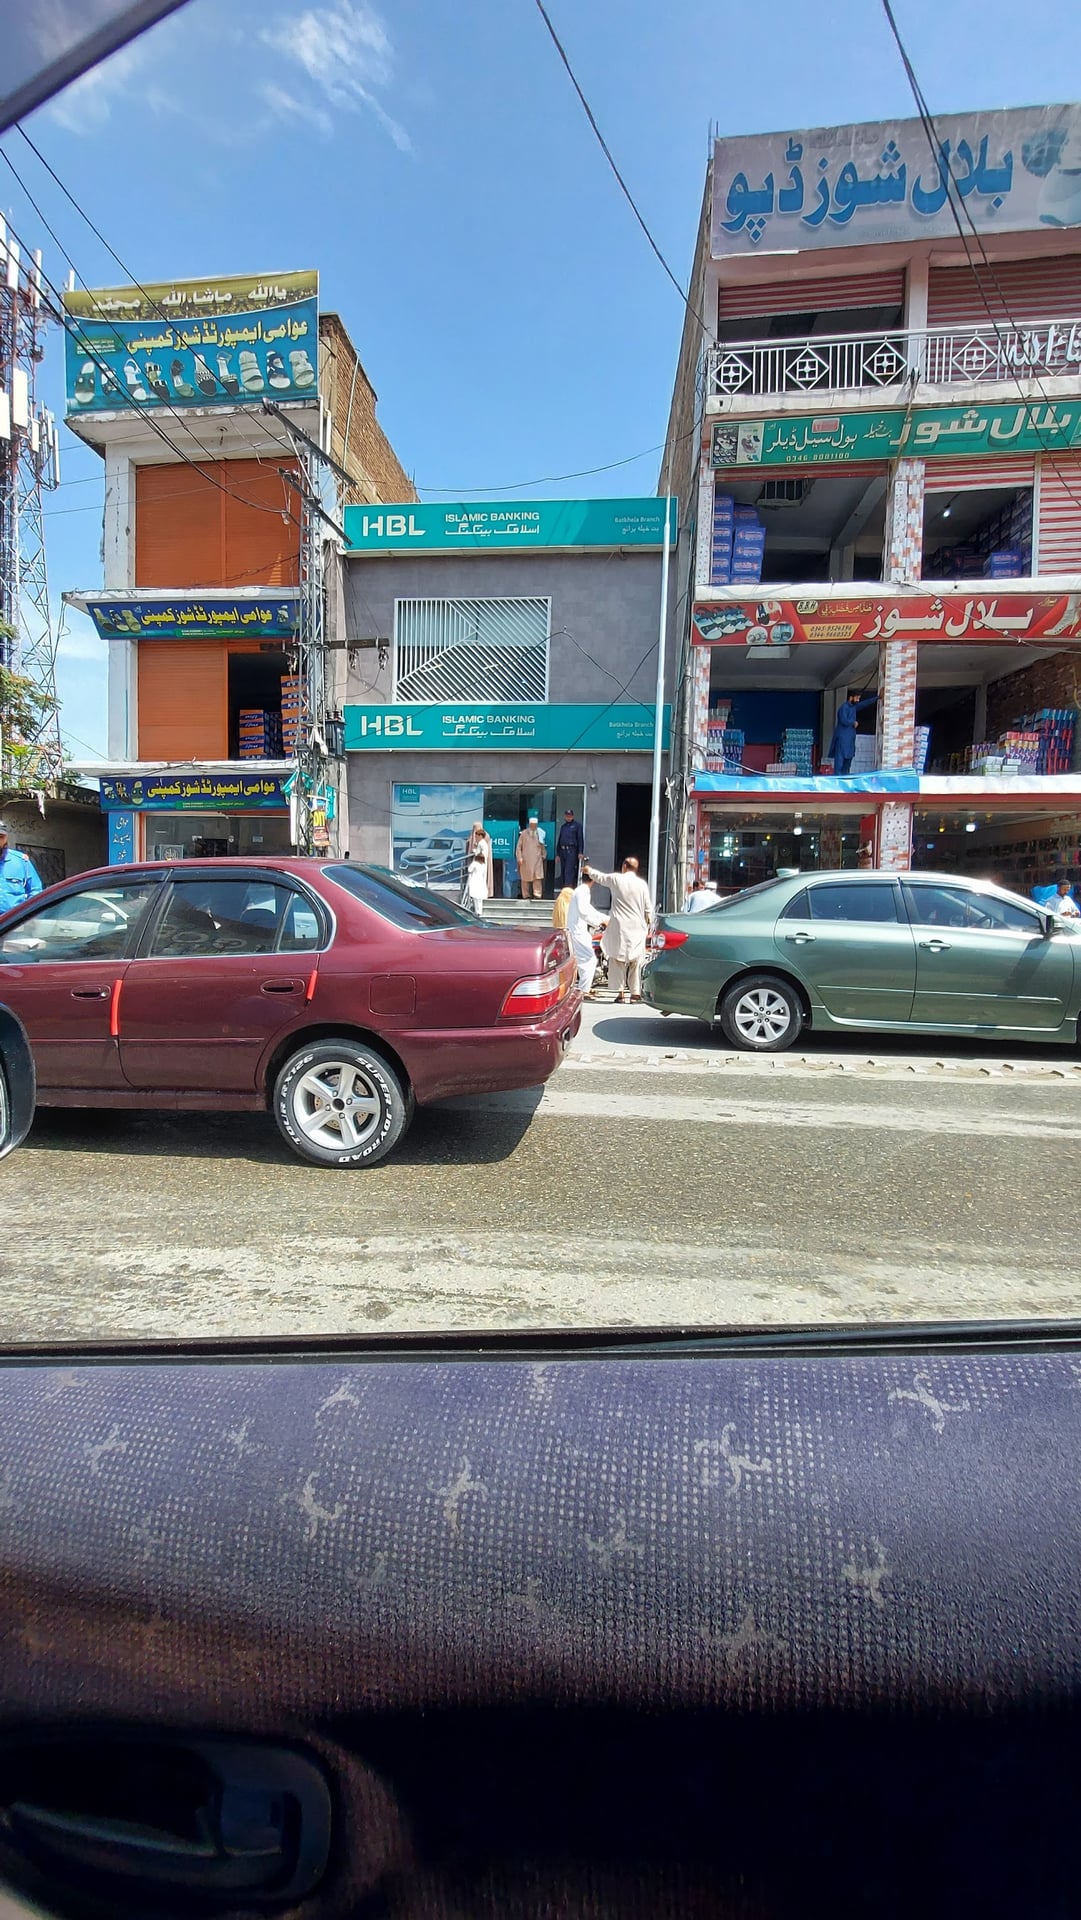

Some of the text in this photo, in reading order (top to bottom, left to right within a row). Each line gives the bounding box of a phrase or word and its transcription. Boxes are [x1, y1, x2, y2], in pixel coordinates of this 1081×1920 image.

[720, 134, 1014, 243] بلال شوز ڈپو
[174, 325, 201, 350] شوز
[263, 318, 308, 343] عوامی
[127, 328, 173, 356] کمپنی
[889, 409, 988, 445] شوز
[990, 406, 1072, 440] بلال
[362, 514, 427, 537] HBL
[445, 512, 540, 522] ISLAMIC BANKING
[640, 515, 660, 523] Branch
[445, 523, 540, 537] اسلامک بینکنگ
[141, 608, 175, 627] کمپنی
[176, 607, 196, 625] شوز
[240, 607, 273, 624] عوامی
[863, 599, 1034, 639] بلال شوز
[361, 715, 424, 736] HBL
[442, 715, 535, 723] ISLAMIC BANKING
[442, 725, 535, 738] اسلامک بینکنگ
[147, 781, 181, 799] کمپنی
[180, 780, 201, 797] شوز
[243, 780, 276, 796] عوامی
[490, 838, 511, 846] HBL
[338, 1057, 393, 1163] SUPER JOYROAD
[279, 1102, 302, 1145] TOUR
